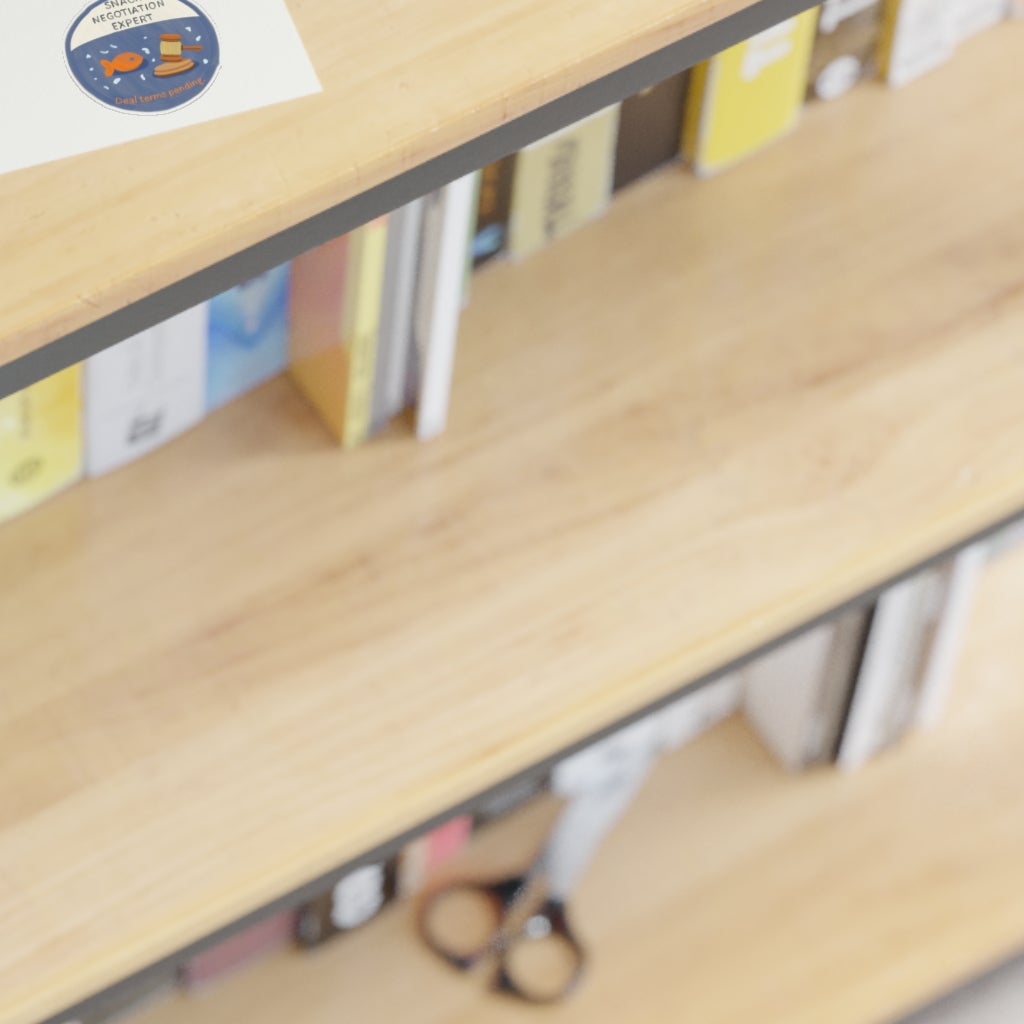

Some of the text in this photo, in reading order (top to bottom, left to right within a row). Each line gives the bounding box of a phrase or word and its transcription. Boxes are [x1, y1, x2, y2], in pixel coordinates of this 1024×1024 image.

[92, 0, 165, 24] NEGOTIATION
[111, 13, 153, 30] EXPERT
[115, 95, 138, 105] Deal
[139, 91, 167, 103] terms
